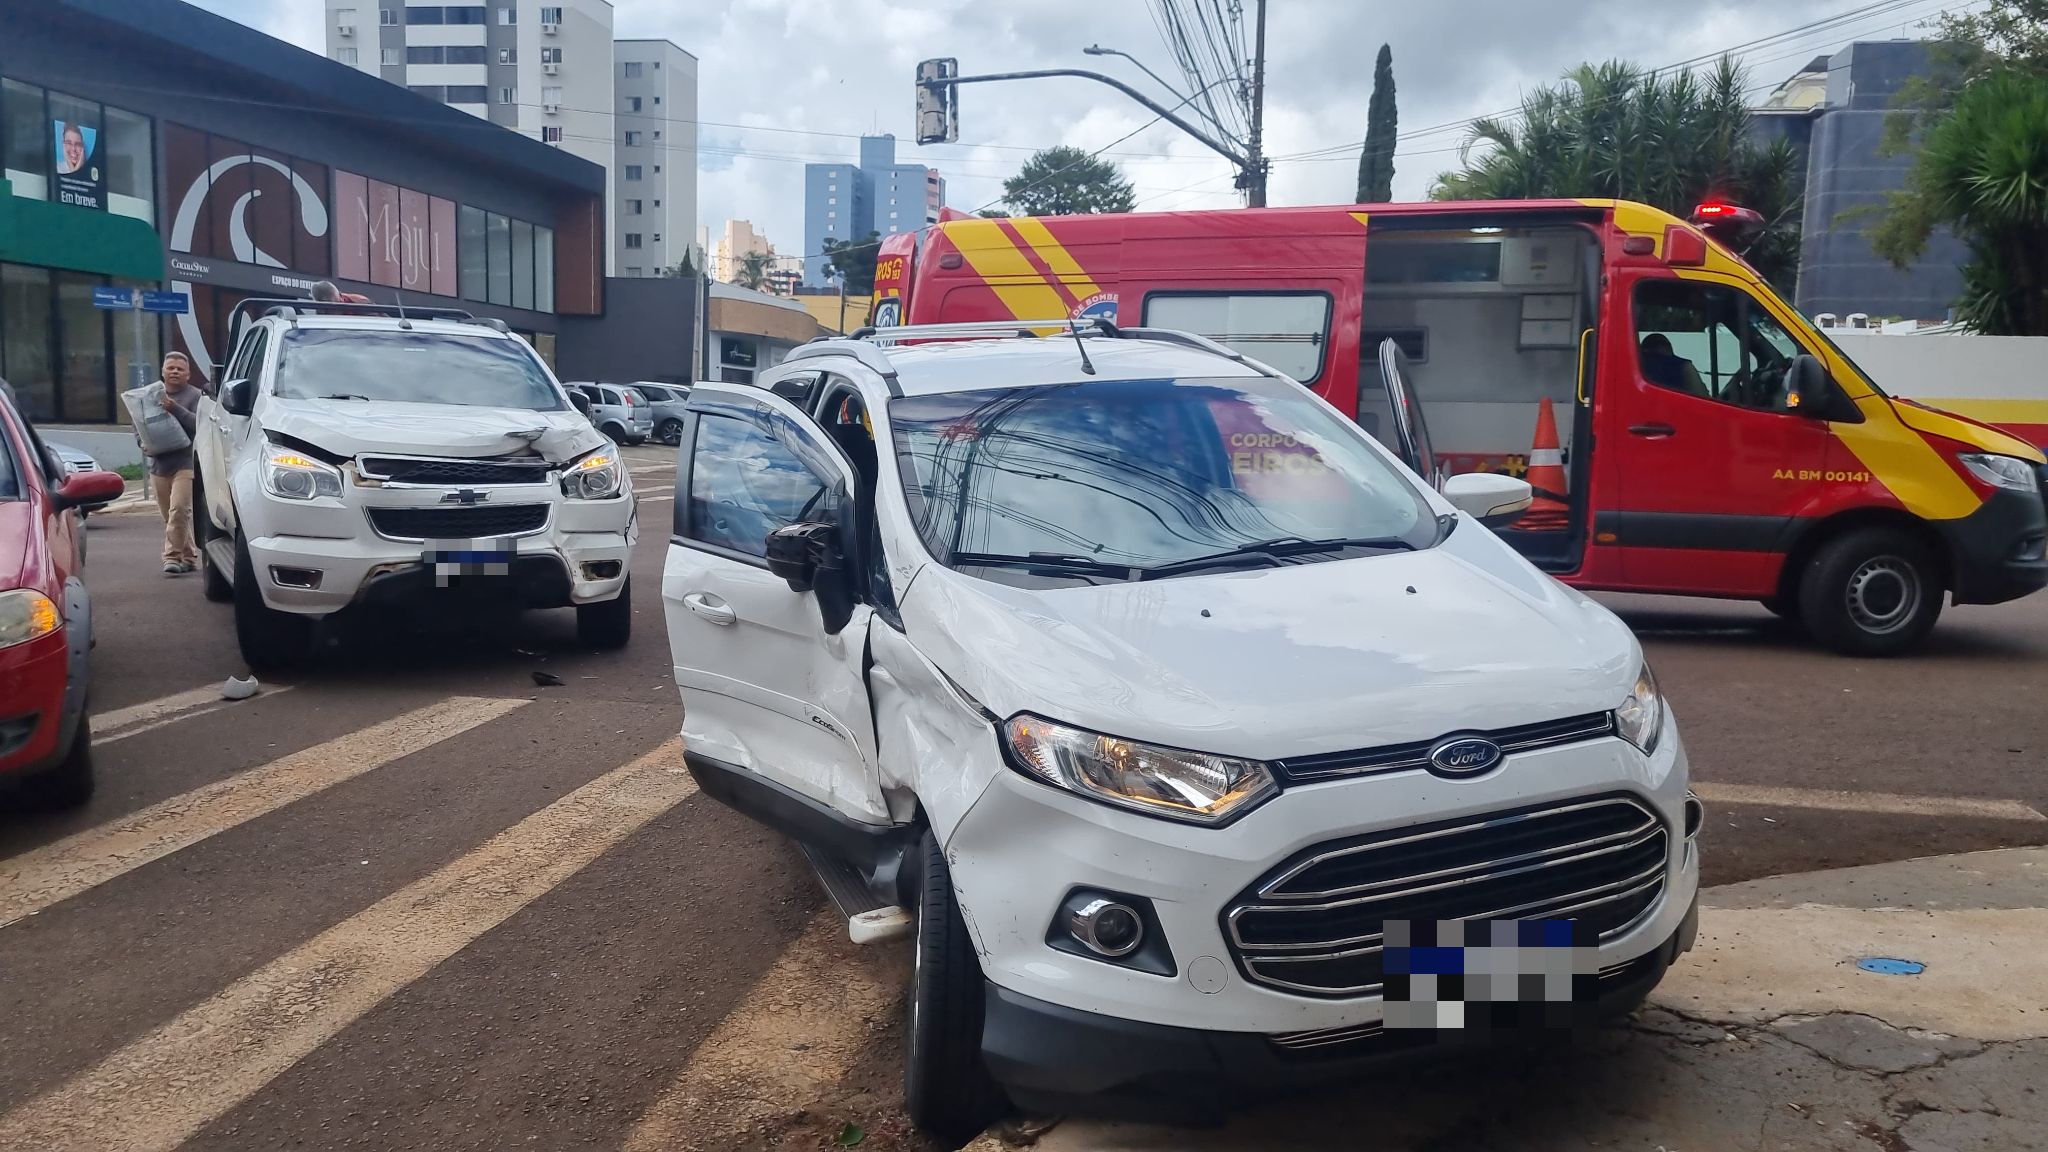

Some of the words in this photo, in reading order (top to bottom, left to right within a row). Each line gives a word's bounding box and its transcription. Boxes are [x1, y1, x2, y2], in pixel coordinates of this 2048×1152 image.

[61, 191, 74, 204] Em
[357, 197, 440, 285] Maju
[876, 260, 893, 281] IROS
[271, 275, 292, 288] ESPAÇO
[1072, 304, 1085, 317] DE
[1086, 293, 1119, 306] BOMBE
[1232, 452, 1329, 475] EIROS
[1772, 469, 1795, 480] AA
[1799, 470, 1821, 481] BM
[1825, 471, 1870, 482] 00141
[1450, 745, 1486, 766] Ford
